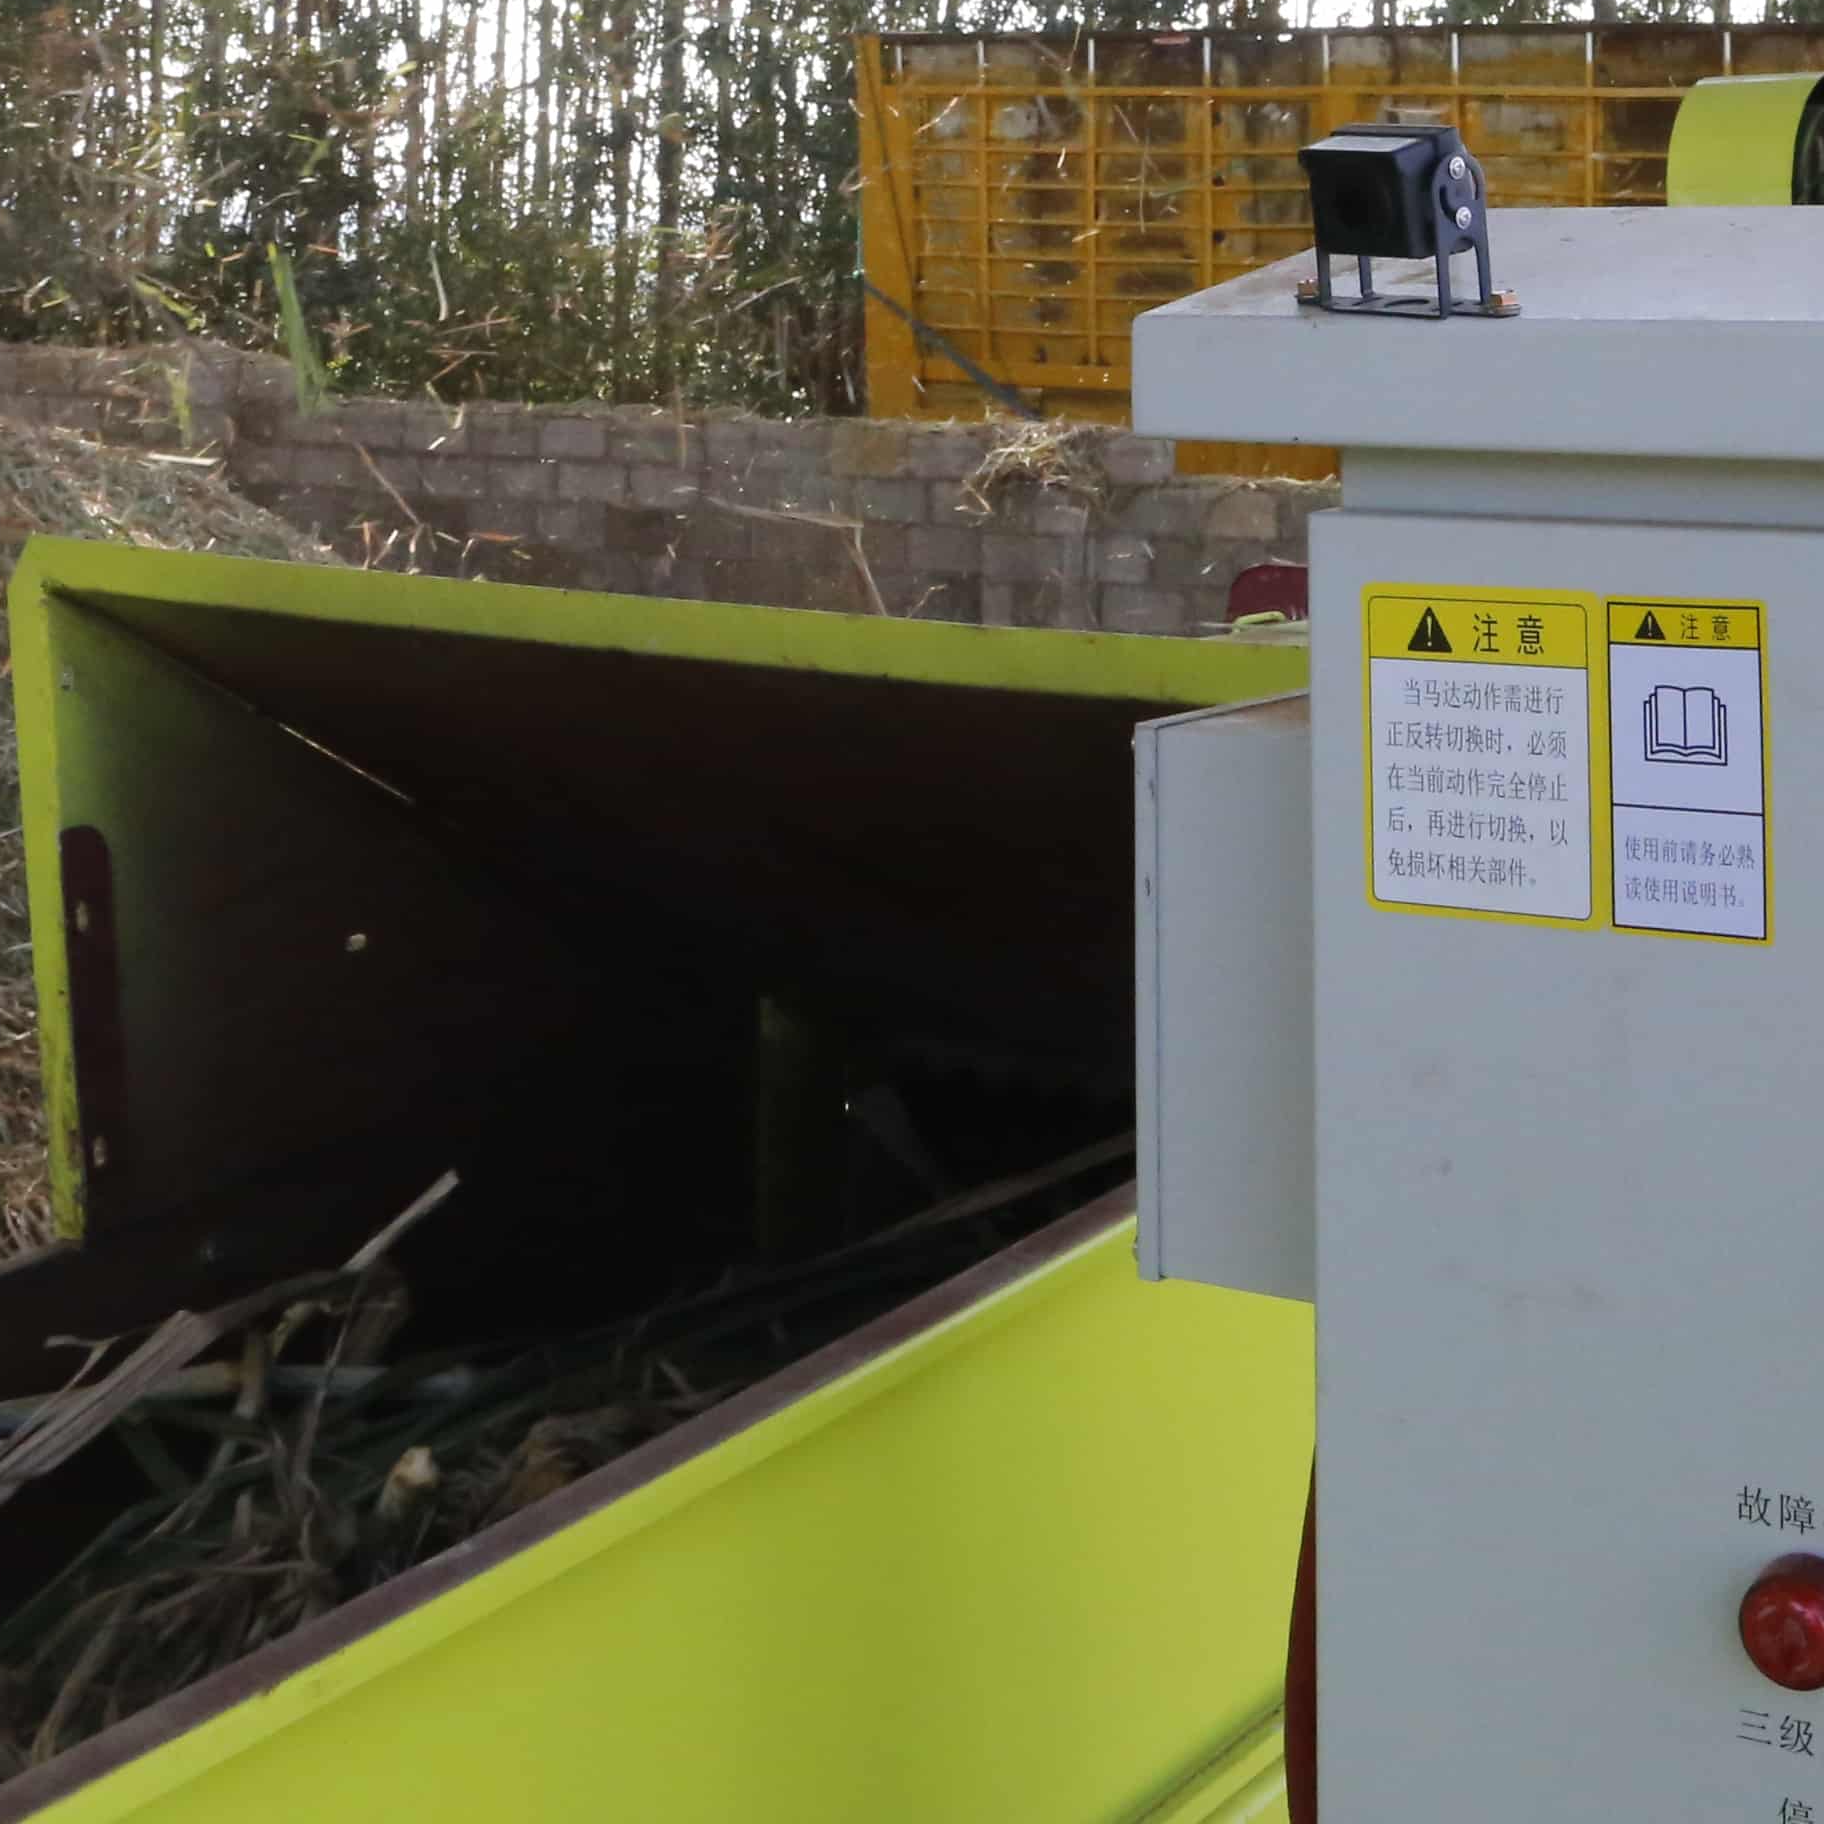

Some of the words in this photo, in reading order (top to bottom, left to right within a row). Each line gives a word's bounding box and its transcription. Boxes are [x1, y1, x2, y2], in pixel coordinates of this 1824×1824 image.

[1472, 612, 1545, 656] 注意
[1679, 612, 1732, 642] 注意
[1403, 677, 1564, 716] 当马达动作需进行
[1386, 761, 1569, 802] 在当前动作完全停止
[1624, 834, 1756, 872] 使用前请务必熟
